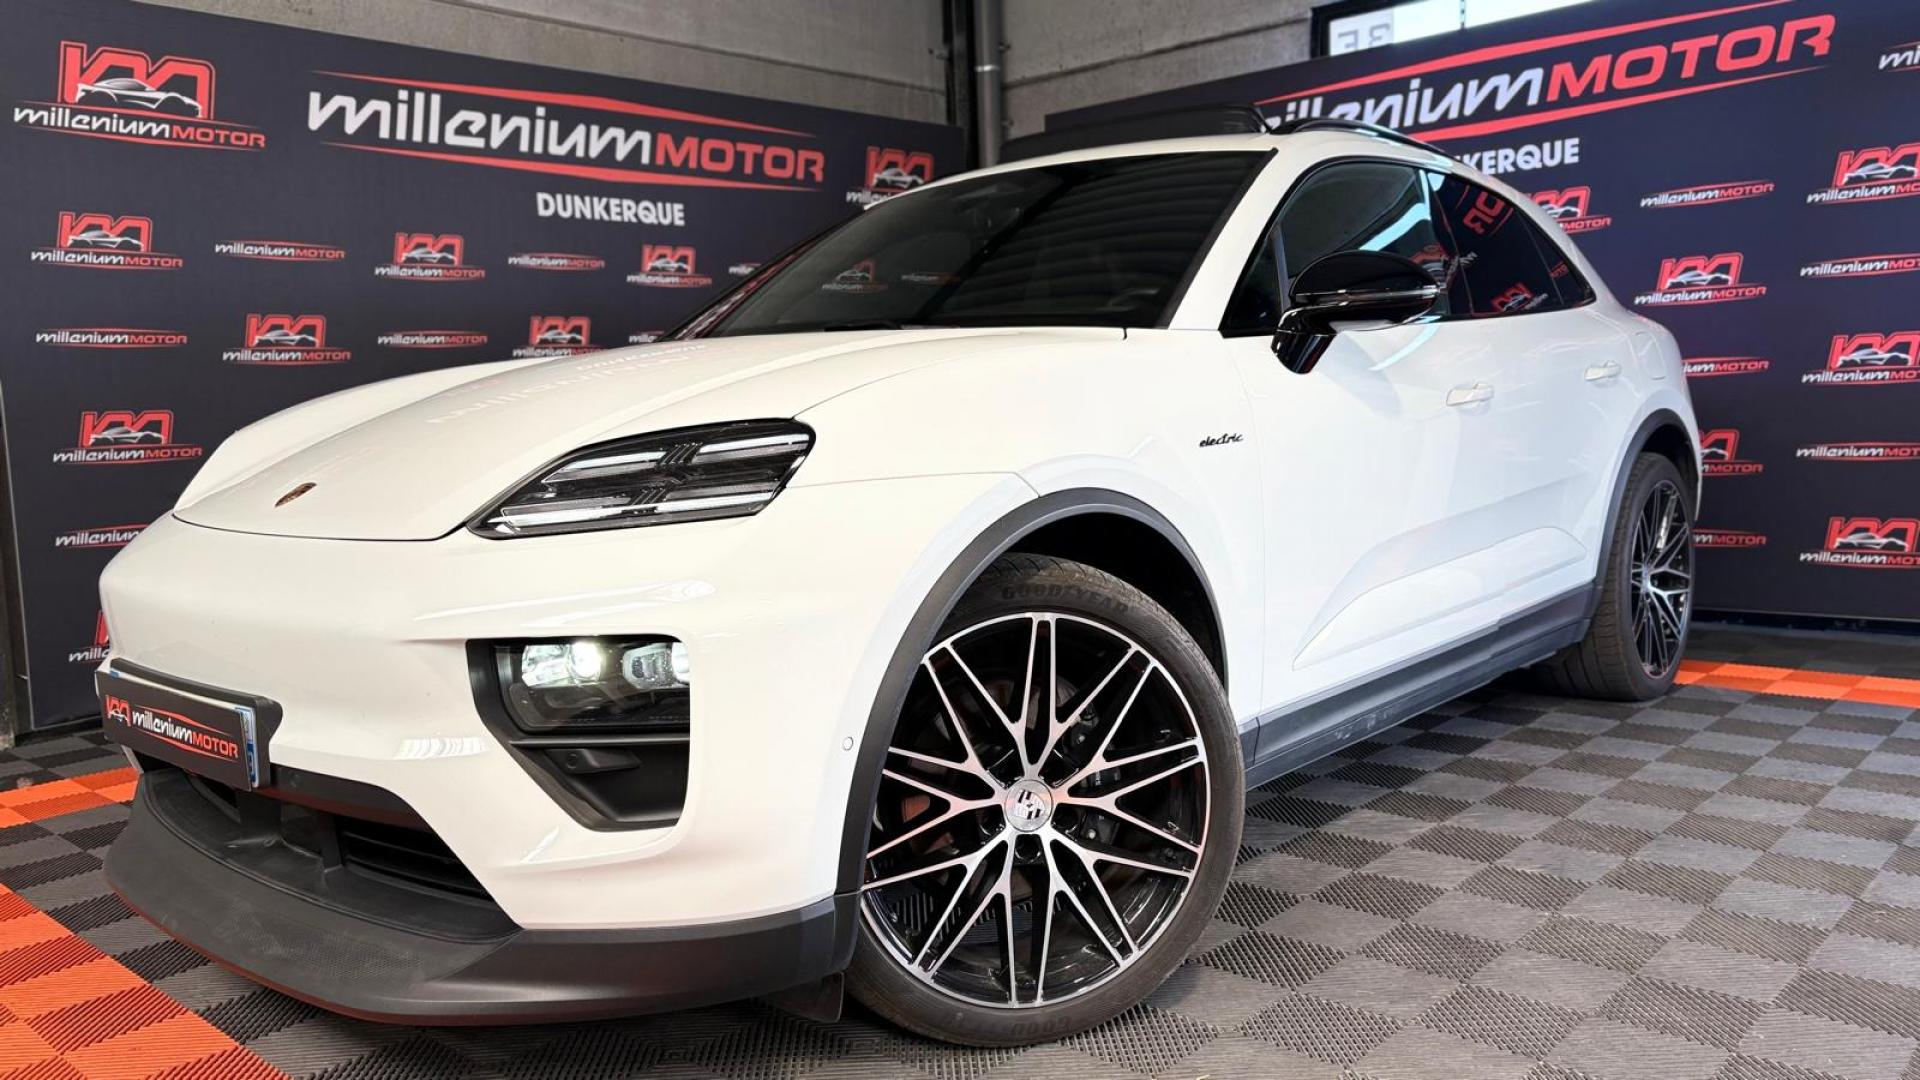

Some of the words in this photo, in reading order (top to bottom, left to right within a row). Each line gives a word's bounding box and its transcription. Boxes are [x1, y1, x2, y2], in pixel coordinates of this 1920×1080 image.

[13, 106, 266, 149] milleniumMOTOR
[308, 89, 826, 183] milleniumMOTOR
[1640, 182, 1775, 207] milleniumMOTOR
[536, 191, 685, 227] DUNKERQUE
[31, 249, 183, 268] milleniumMOTOR
[215, 242, 346, 260] milleniumMOTOR
[1634, 286, 1767, 305] milleniumMOTOR
[36, 330, 188, 345] milleniumMOTOR
[222, 349, 352, 362] milleniumMOTOR
[1199, 433, 1244, 448] electric
[53, 445, 202, 464] milleniumMOTOR
[131, 710, 239, 759] milleniumMOTOR
